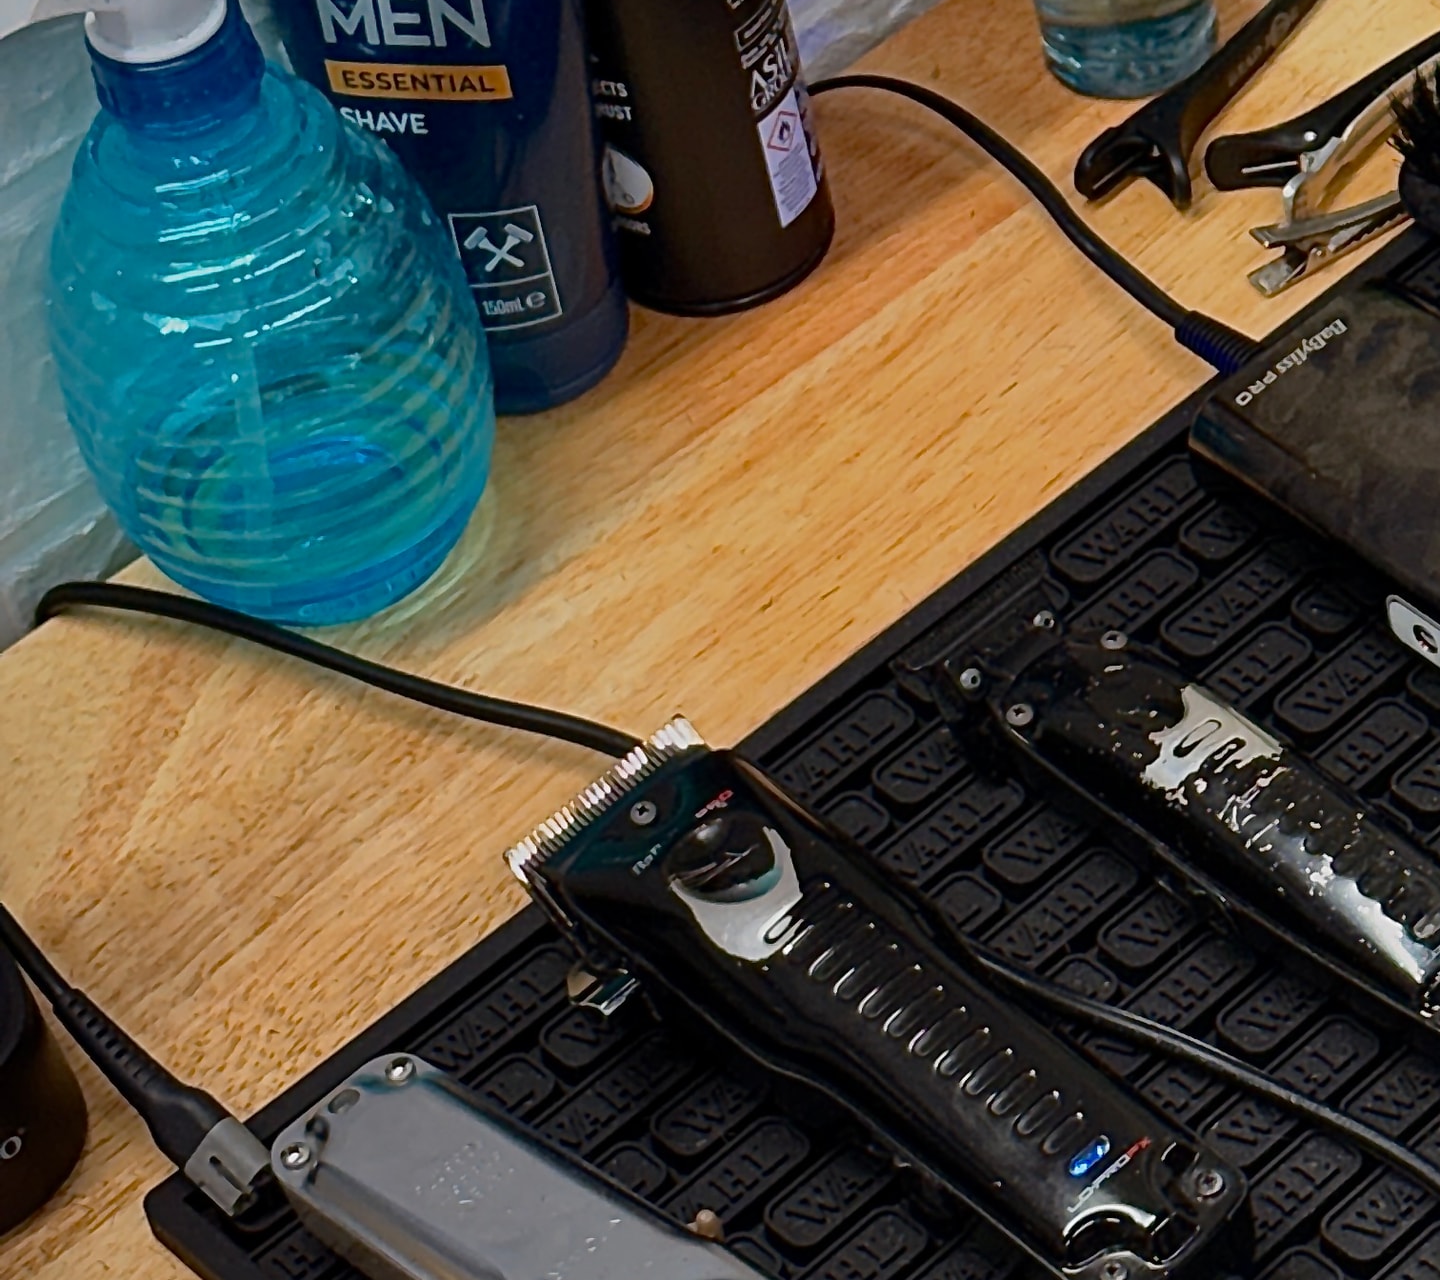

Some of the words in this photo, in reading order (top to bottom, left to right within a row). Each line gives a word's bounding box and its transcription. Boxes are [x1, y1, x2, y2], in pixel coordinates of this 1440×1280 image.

[341, 69, 497, 94] ESSENTIAL
[339, 106, 430, 136] SHAVE
[1275, 318, 1349, 375] BaByliss
[1234, 369, 1278, 408] PRO
[1064, 469, 1199, 571] WAHL
[423, 957, 574, 1076] WAHL
